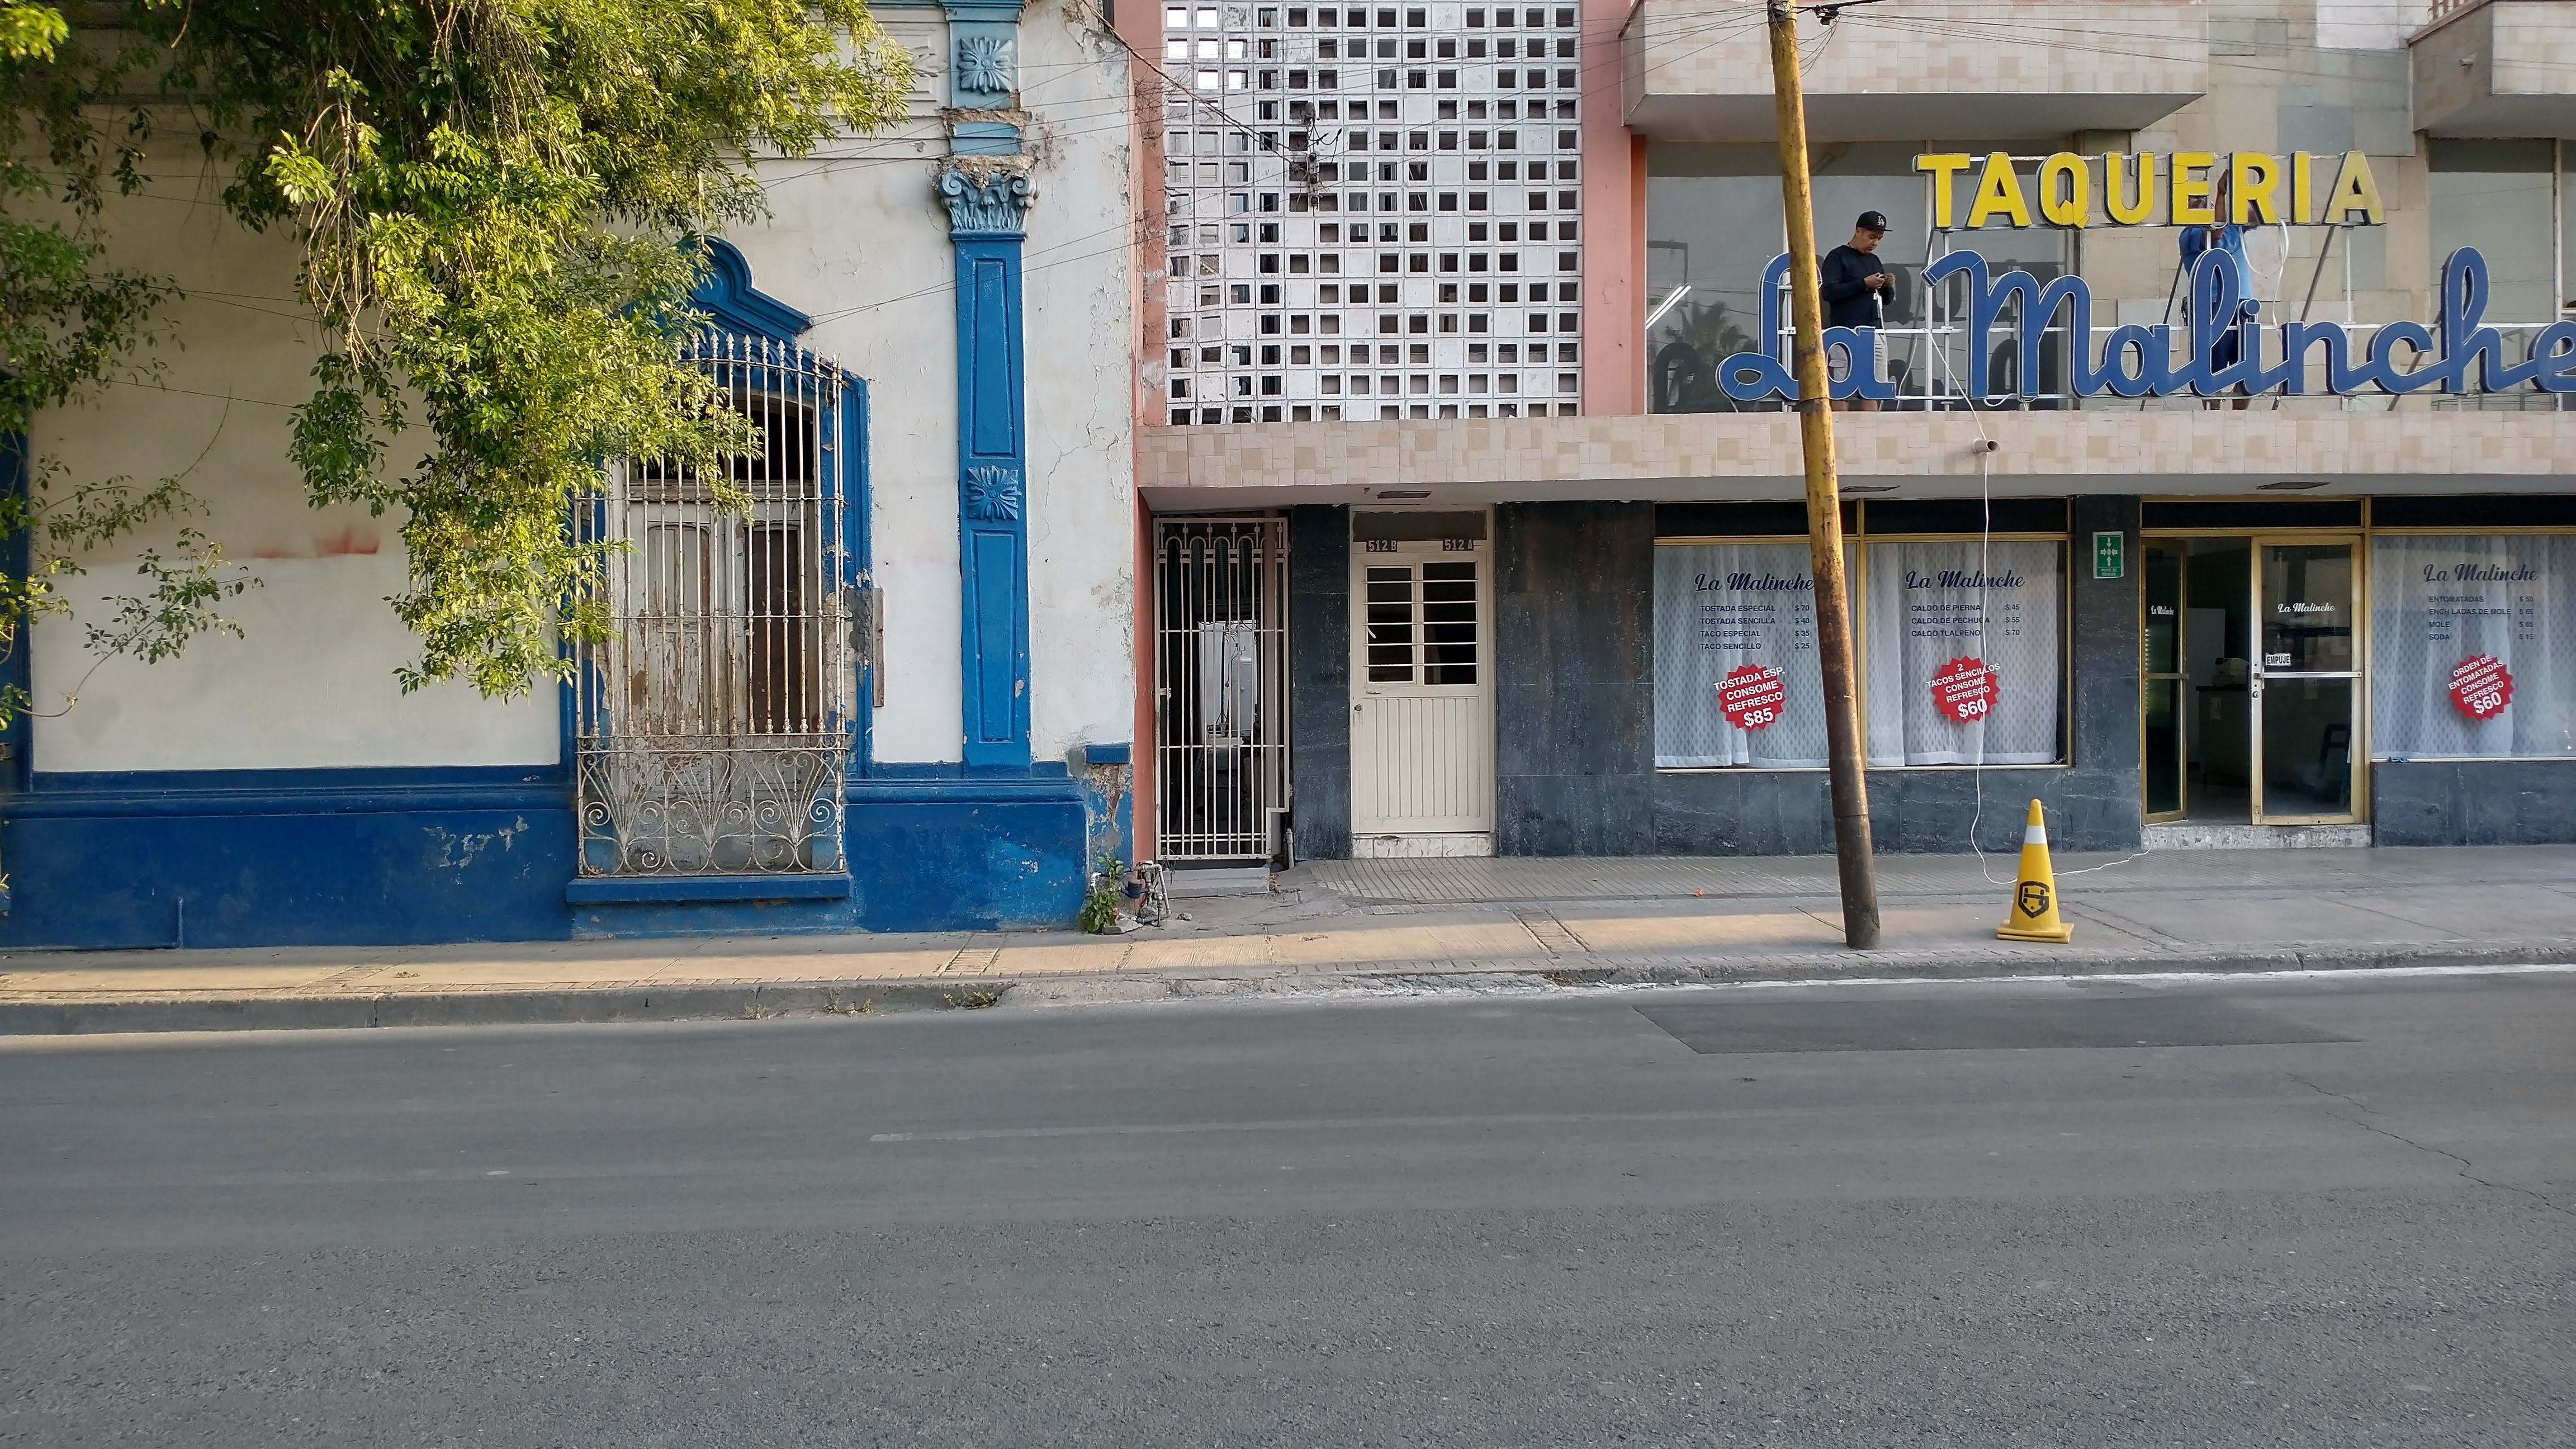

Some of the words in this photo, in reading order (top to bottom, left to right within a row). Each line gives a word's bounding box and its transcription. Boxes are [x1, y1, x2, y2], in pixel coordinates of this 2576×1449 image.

[1913, 151, 2386, 228] TAQUERIA
[1877, 215, 1885, 226] LA
[1715, 252, 1896, 401] La
[1920, 246, 2576, 399] Malinche
[1368, 540, 1388, 551] 512
[1391, 540, 1396, 551] B
[1445, 539, 1465, 550] 512
[1467, 539, 1472, 550] A
[1694, 573, 1722, 591] La
[1727, 573, 1815, 590] Malinche
[1905, 571, 1933, 589] La
[1938, 570, 2025, 588] Malinche
[2423, 564, 2450, 582] La
[2454, 564, 2539, 581] Malinche
[2277, 603, 2291, 613] La
[2293, 602, 2335, 612] Malinche
[2267, 656, 2290, 664] EMPUJE
[2453, 660, 2480, 677] ORDEN
[2480, 655, 2492, 665] DE
[1713, 673, 1762, 691] TOSTADA
[1763, 666, 1786, 679] ESP.
[1926, 675, 1954, 688] TACOS
[1955, 663, 2001, 680] SENCILLOS
[1945, 676, 1987, 693] CONSOME
[2448, 660, 2504, 690] ENTOMATADAS
[2461, 673, 2499, 694] CONSOME
[1726, 680, 1779, 700] CONSOME
[1946, 685, 1990, 703] REFRESCO
[2463, 681, 2504, 704] REFRESCO
[1727, 692, 1783, 713] REFRESCO
[1958, 699, 1987, 719] $60
[2474, 692, 2502, 714] $60
[1743, 707, 1773, 728] $85
